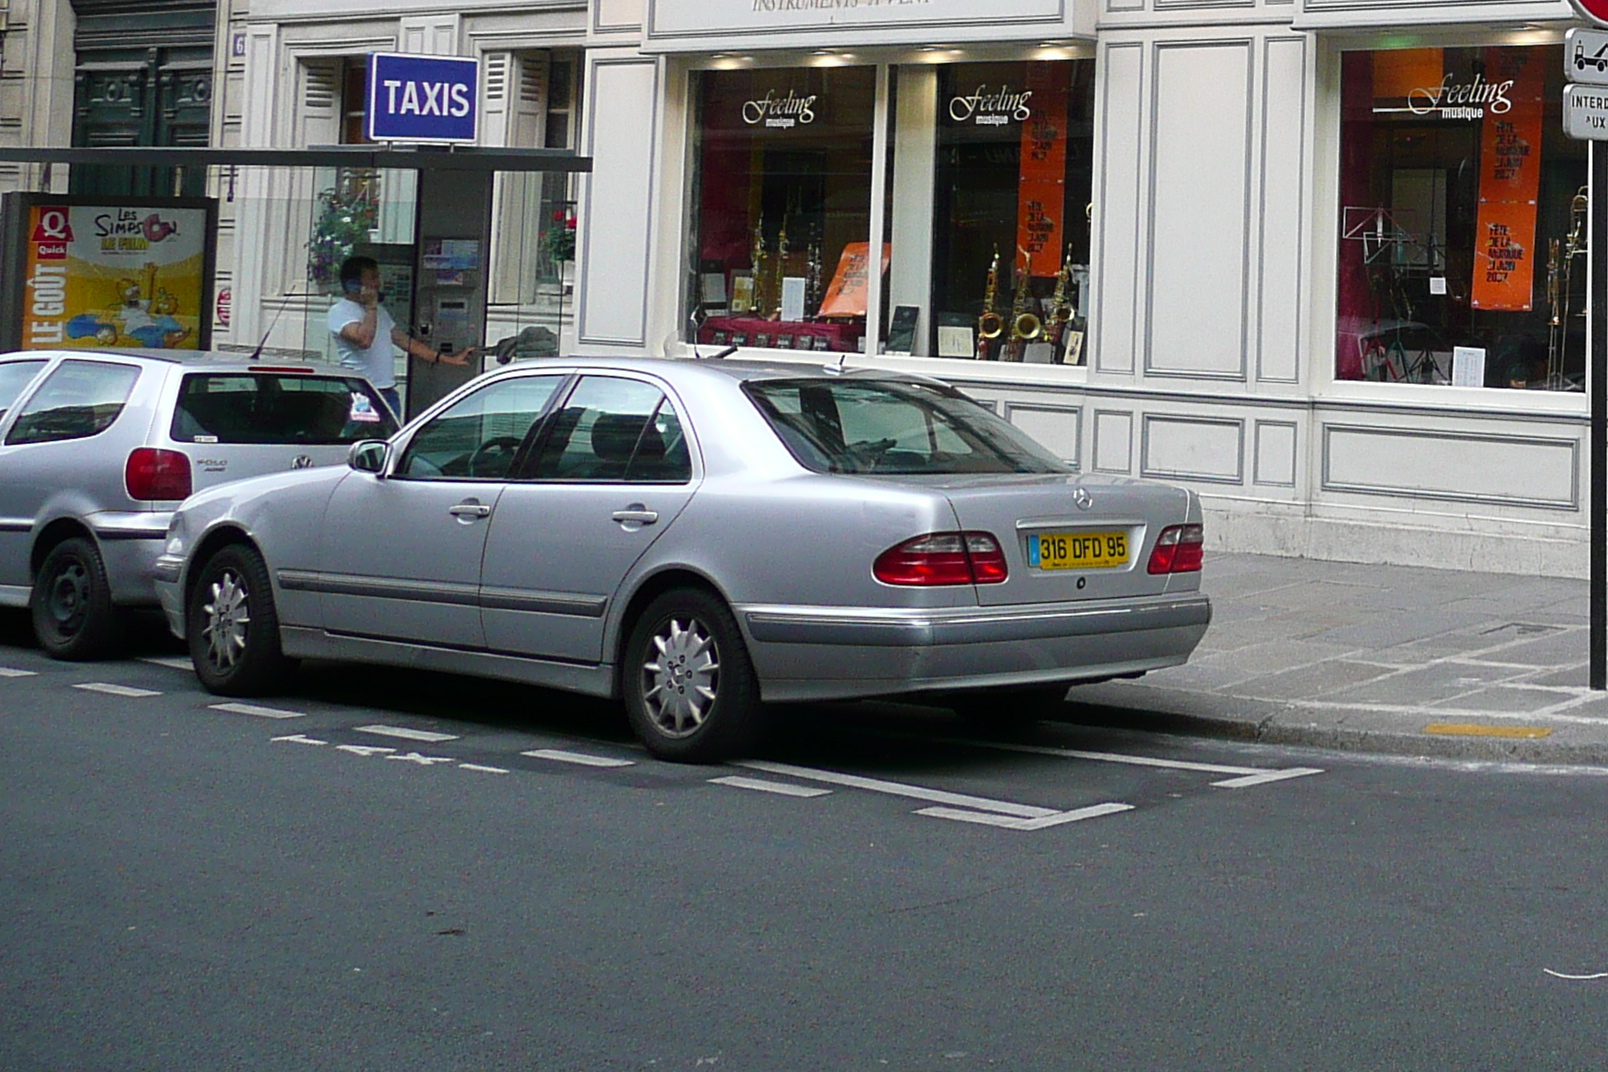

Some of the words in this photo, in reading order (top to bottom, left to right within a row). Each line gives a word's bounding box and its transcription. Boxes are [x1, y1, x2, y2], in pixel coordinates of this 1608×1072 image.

[384, 80, 470, 118] TAXIS
[1442, 106, 1484, 121] musique
[38, 245, 66, 255] Quick
[31, 321, 63, 343] LE
[1041, 539, 1067, 560] 316
[1073, 538, 1102, 559] DFD
[1107, 537, 1126, 557] 95
